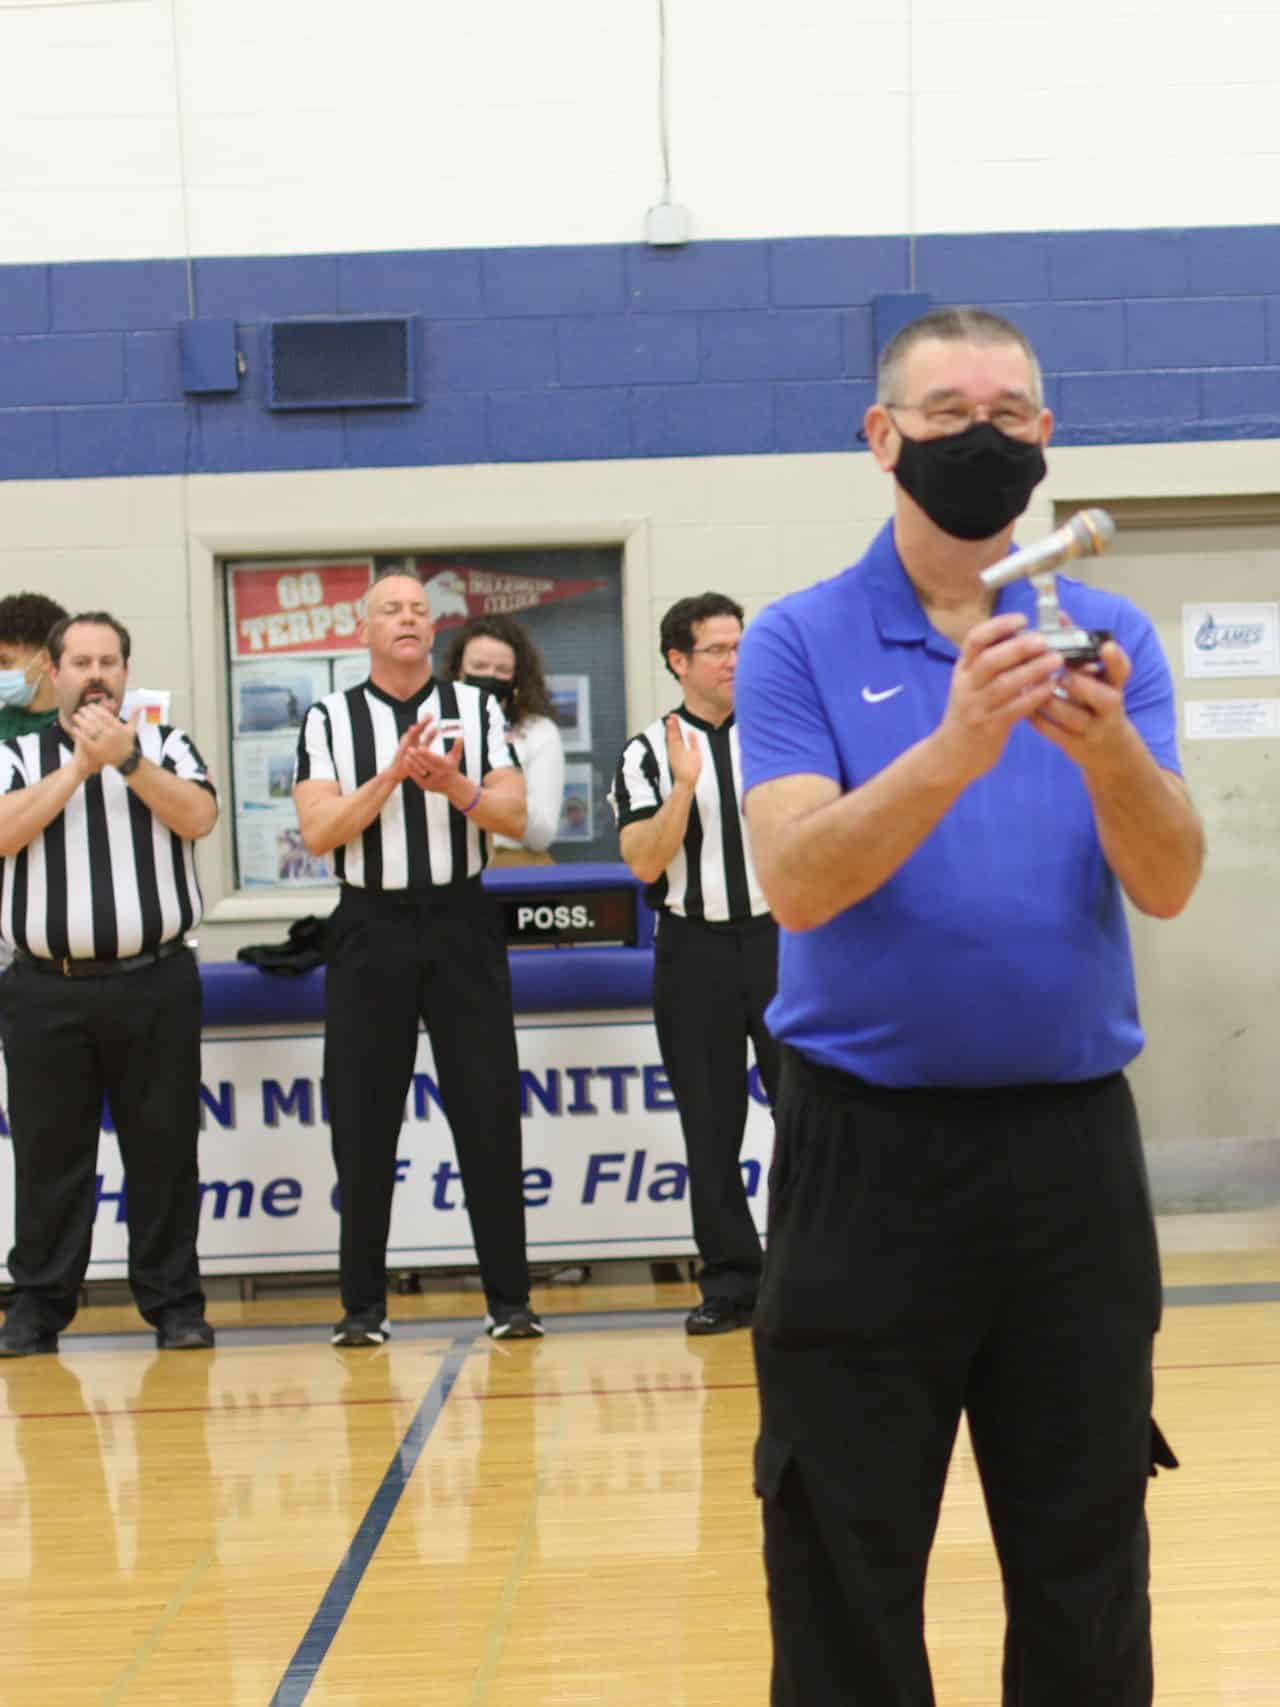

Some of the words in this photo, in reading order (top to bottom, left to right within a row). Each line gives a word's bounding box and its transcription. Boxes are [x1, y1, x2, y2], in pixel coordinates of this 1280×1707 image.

[277, 572, 323, 609] GO
[517, 905, 595, 930] POSS.
[93, 1174, 302, 1223] Hme
[432, 1162, 553, 1211] te
